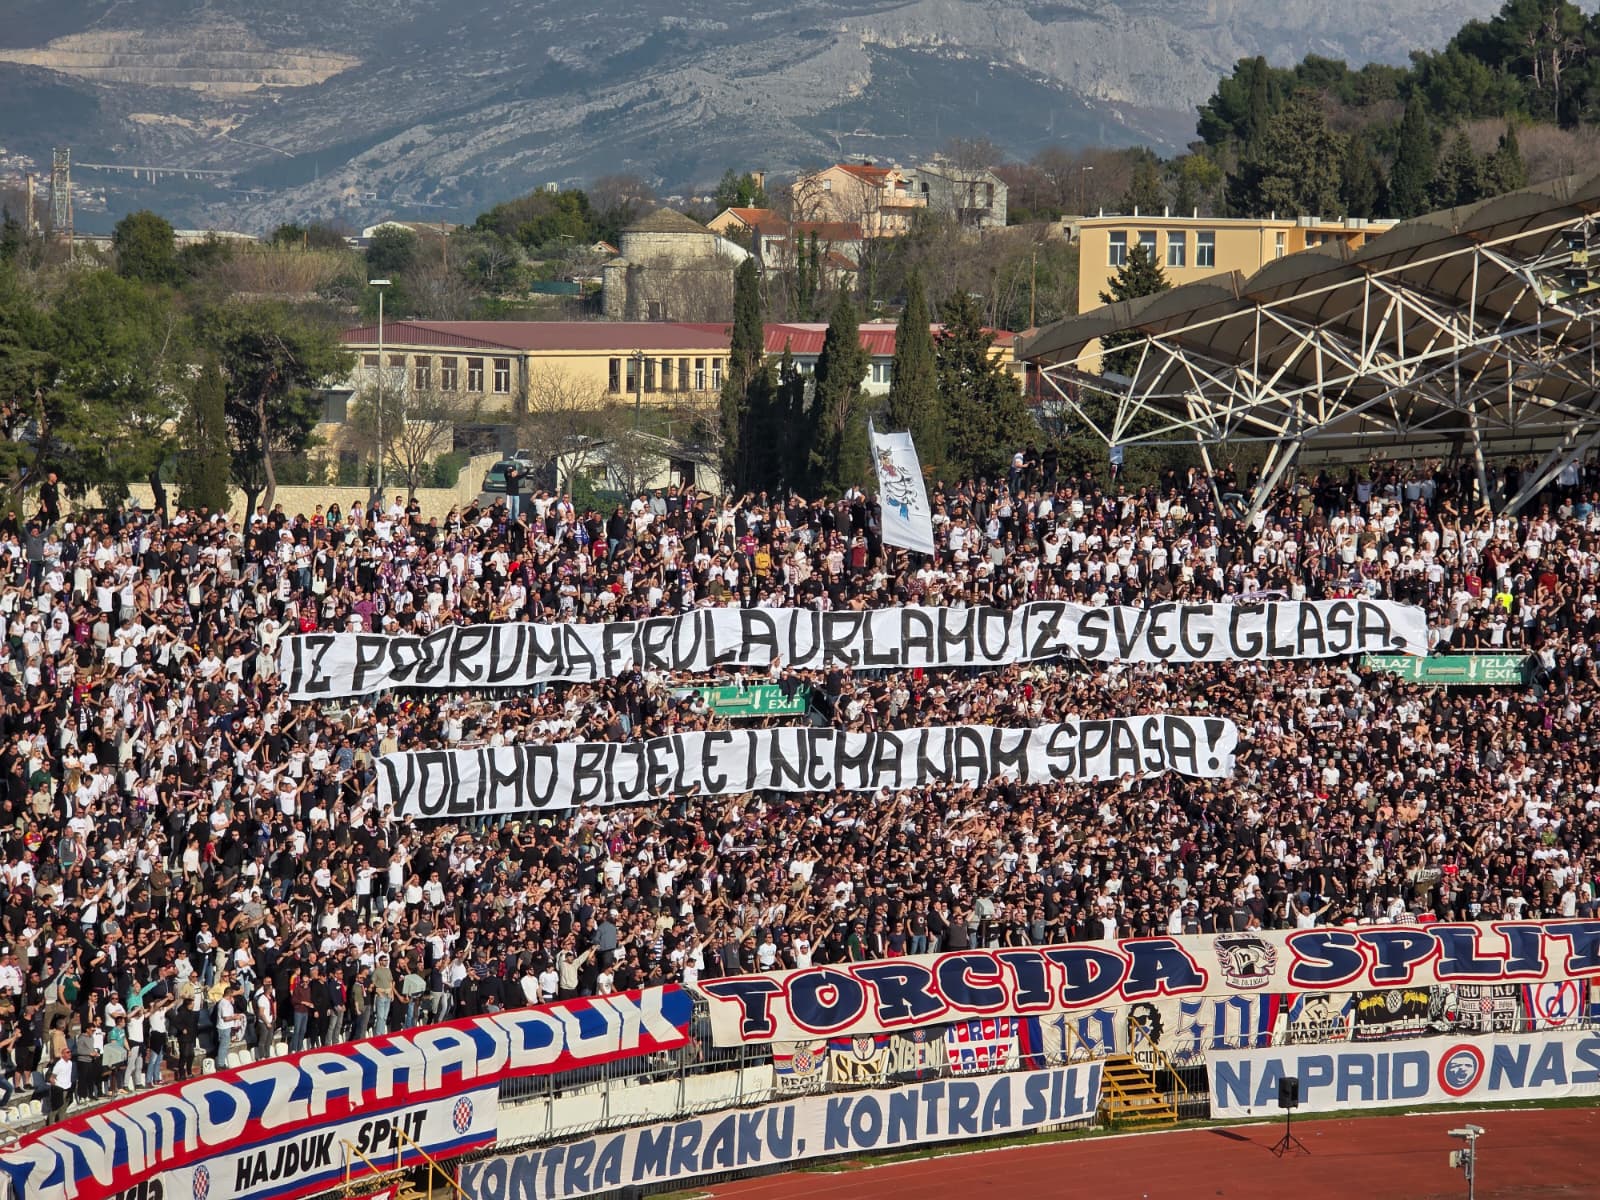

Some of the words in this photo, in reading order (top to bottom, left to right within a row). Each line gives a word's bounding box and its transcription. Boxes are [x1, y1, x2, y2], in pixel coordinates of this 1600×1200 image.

[288, 636, 335, 694] IZ
[352, 622, 598, 691] PODRUMA
[787, 606, 1005, 666] URLAMO
[1020, 602, 1066, 660] IZ
[1077, 601, 1215, 660] SVEG
[1229, 600, 1408, 658] GLASA.
[386, 744, 560, 817] VOLIMO
[572, 730, 732, 807] BIJELE
[744, 729, 758, 790] I
[770, 728, 901, 790] NEMA
[917, 726, 1030, 790] NAM
[1046, 716, 1225, 780] SPASA!
[700, 937, 1208, 1040] TORCIDA
[238, 1053, 366, 1130] ZA
[352, 986, 685, 1100] HAJDUK
[1215, 1049, 1430, 1109] NAPRID
[235, 1131, 336, 1192] HAJDUK
[352, 1109, 428, 1157] SPLIT
[460, 1133, 627, 1200] KONTRA
[632, 1104, 806, 1182] MRAKU,
[824, 1077, 1016, 1151] KONTRA
[1022, 1065, 1102, 1125] SILI
